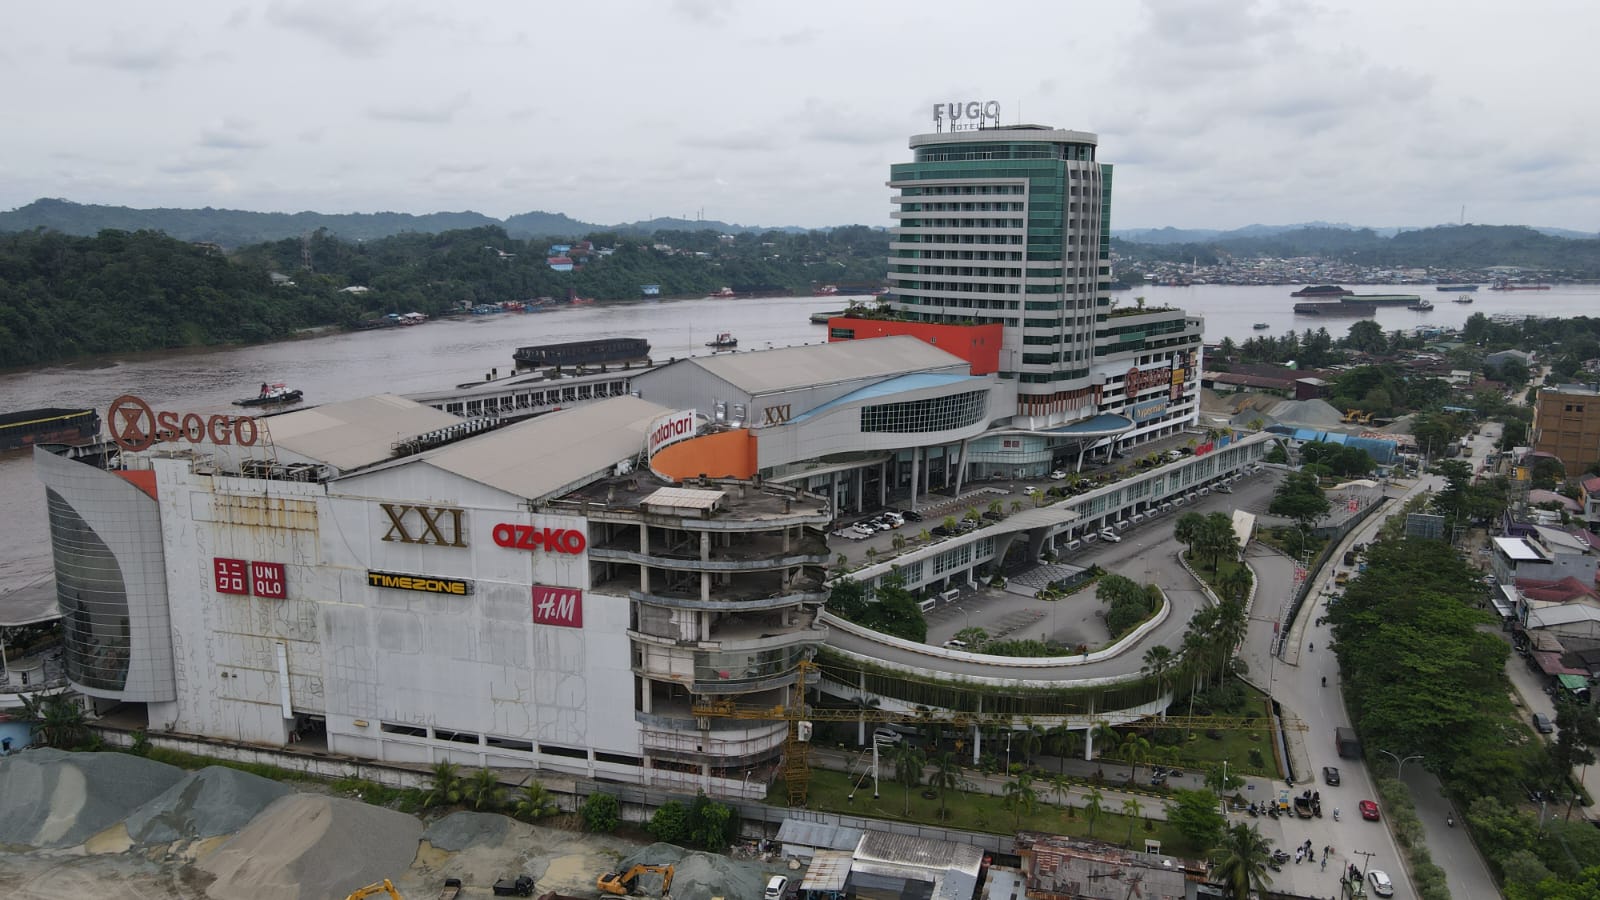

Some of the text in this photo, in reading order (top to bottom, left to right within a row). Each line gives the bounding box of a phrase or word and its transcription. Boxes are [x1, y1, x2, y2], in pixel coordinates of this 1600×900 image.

[933, 100, 1000, 121] FUGO
[157, 411, 257, 447] SOGO
[764, 404, 791, 425] XXI
[649, 412, 692, 448] matahari
[380, 503, 467, 548] XXI
[369, 574, 466, 595] TIMEZONE
[537, 592, 576, 622] H&M
